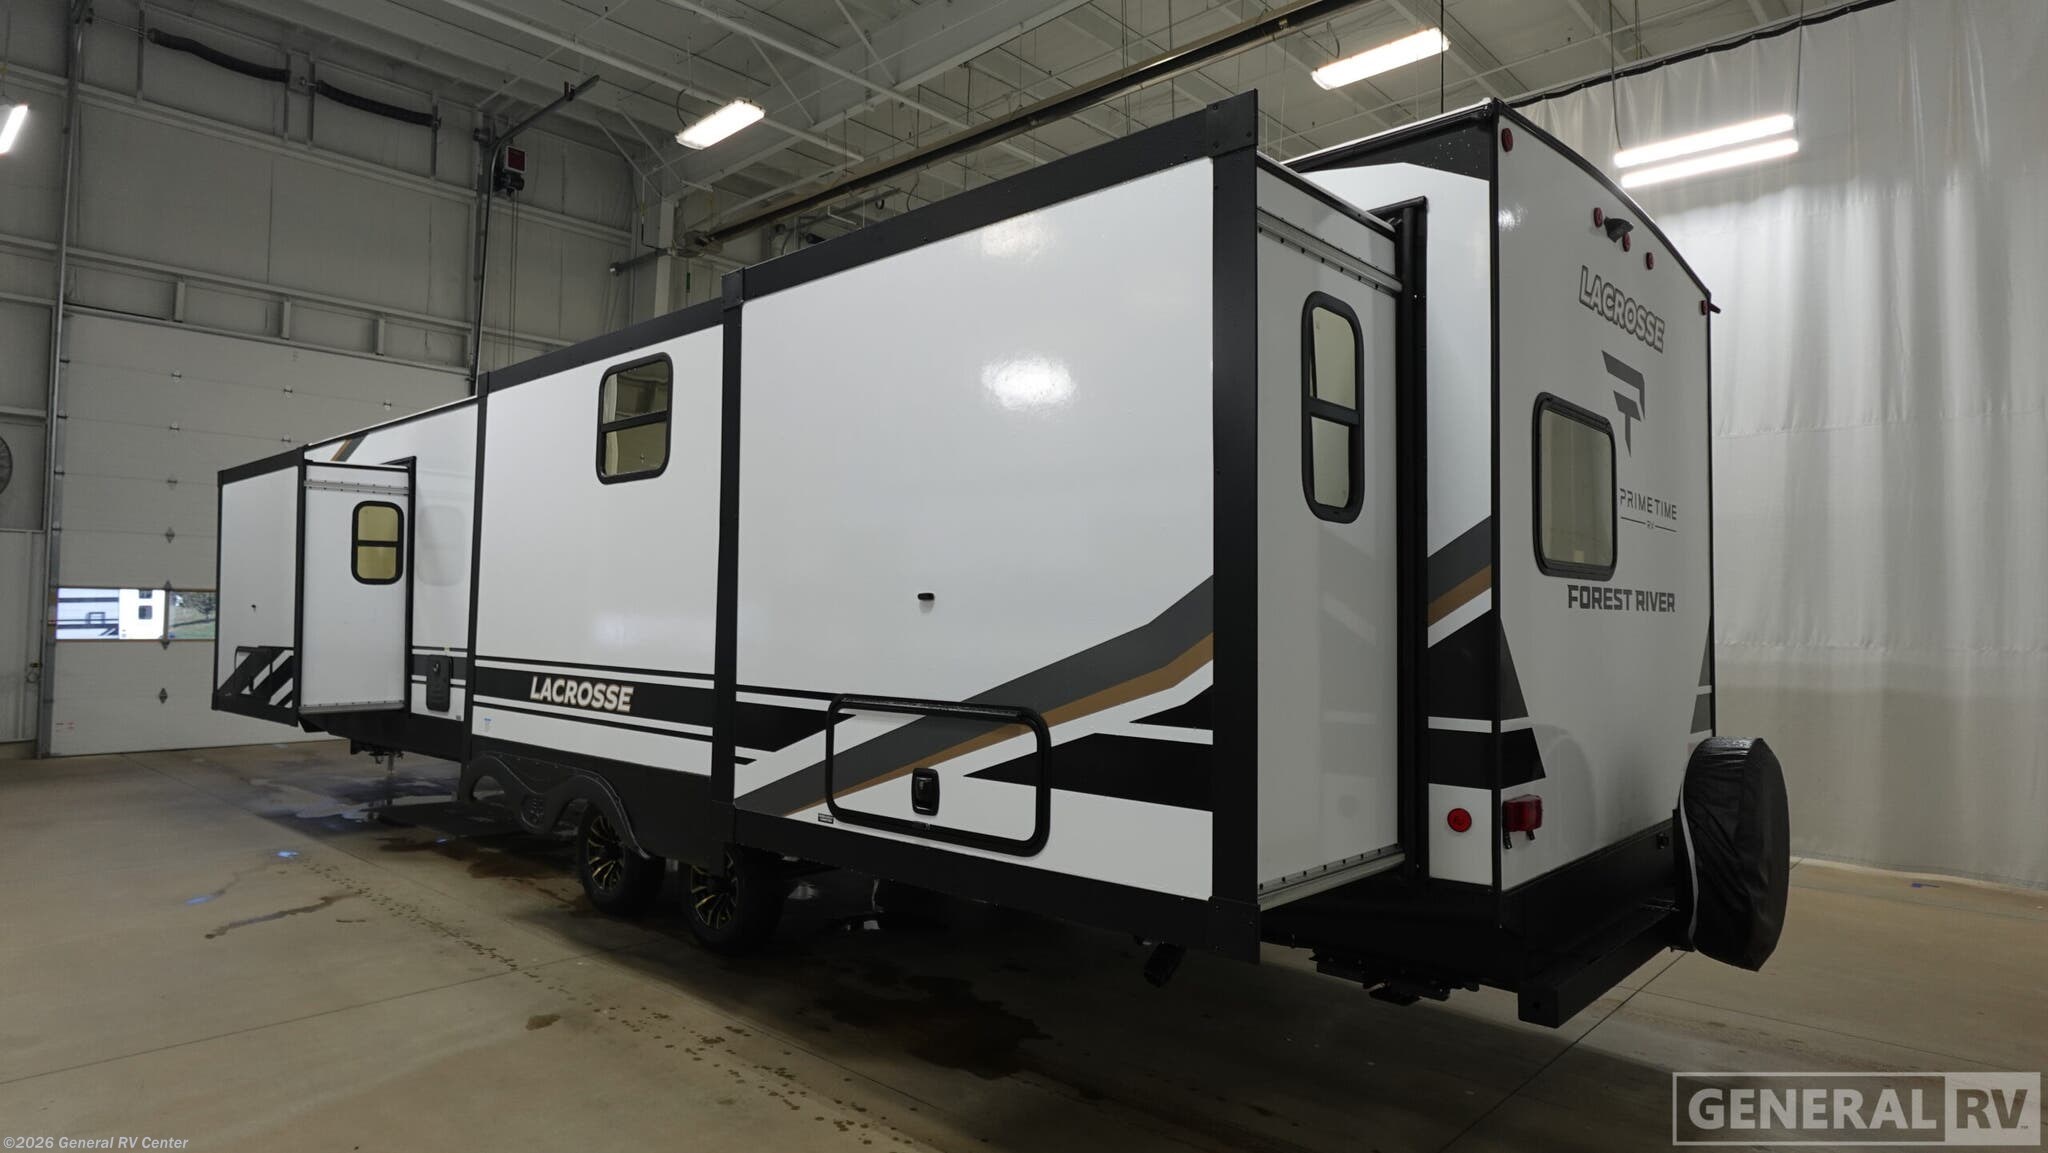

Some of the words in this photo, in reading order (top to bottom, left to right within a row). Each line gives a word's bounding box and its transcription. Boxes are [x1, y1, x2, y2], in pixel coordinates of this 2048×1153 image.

[1579, 265, 1665, 353] LACROSSE
[1568, 584, 1633, 611] FOREST
[1635, 590, 1676, 613] RIVER
[530, 676, 634, 712] LACROSSE
